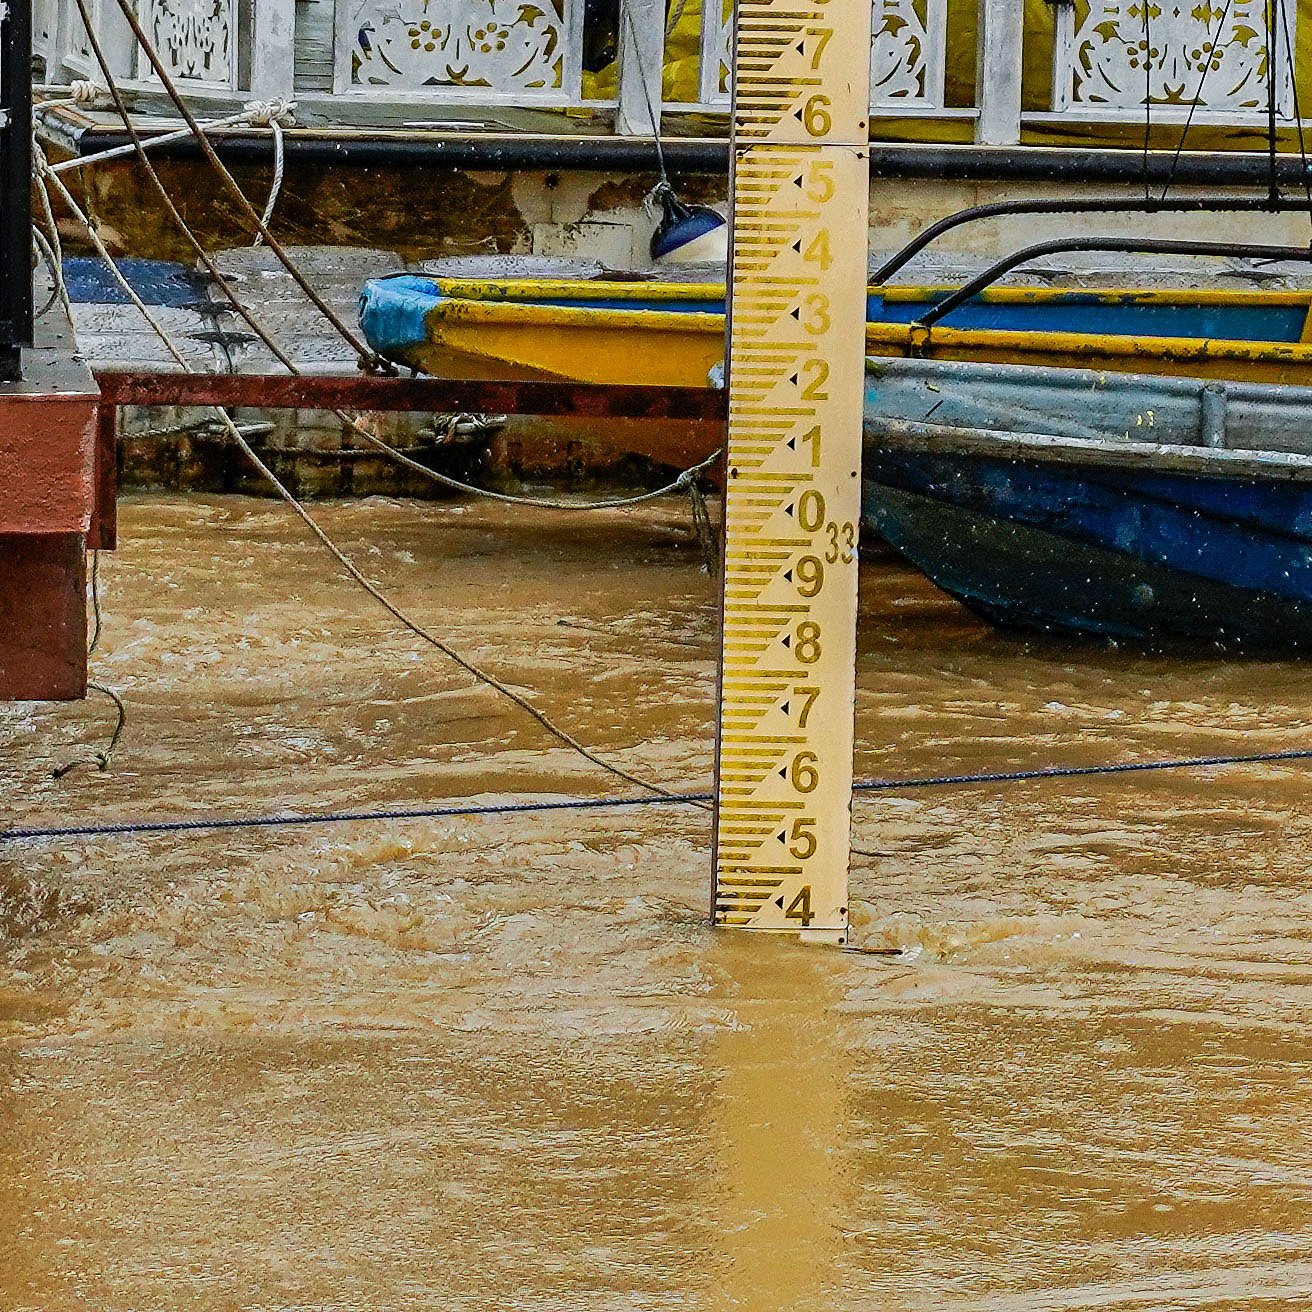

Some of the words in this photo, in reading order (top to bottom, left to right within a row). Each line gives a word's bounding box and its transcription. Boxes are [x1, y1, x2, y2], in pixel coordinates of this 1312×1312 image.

[806, 28, 834, 70] 7
[804, 94, 832, 137] 6
[806, 160, 834, 203] 5
[804, 228, 834, 272] 4
[802, 292, 831, 336] 3
[800, 358, 829, 401] 2
[802, 424, 821, 467] 1
[799, 489, 825, 532] 0
[825, 521, 855, 564] 33
[796, 554, 825, 598] 9
[794, 620, 822, 664] 8
[793, 686, 821, 729] 7
[791, 750, 820, 794] 6
[789, 817, 817, 860] 5
[785, 884, 815, 927] 4
